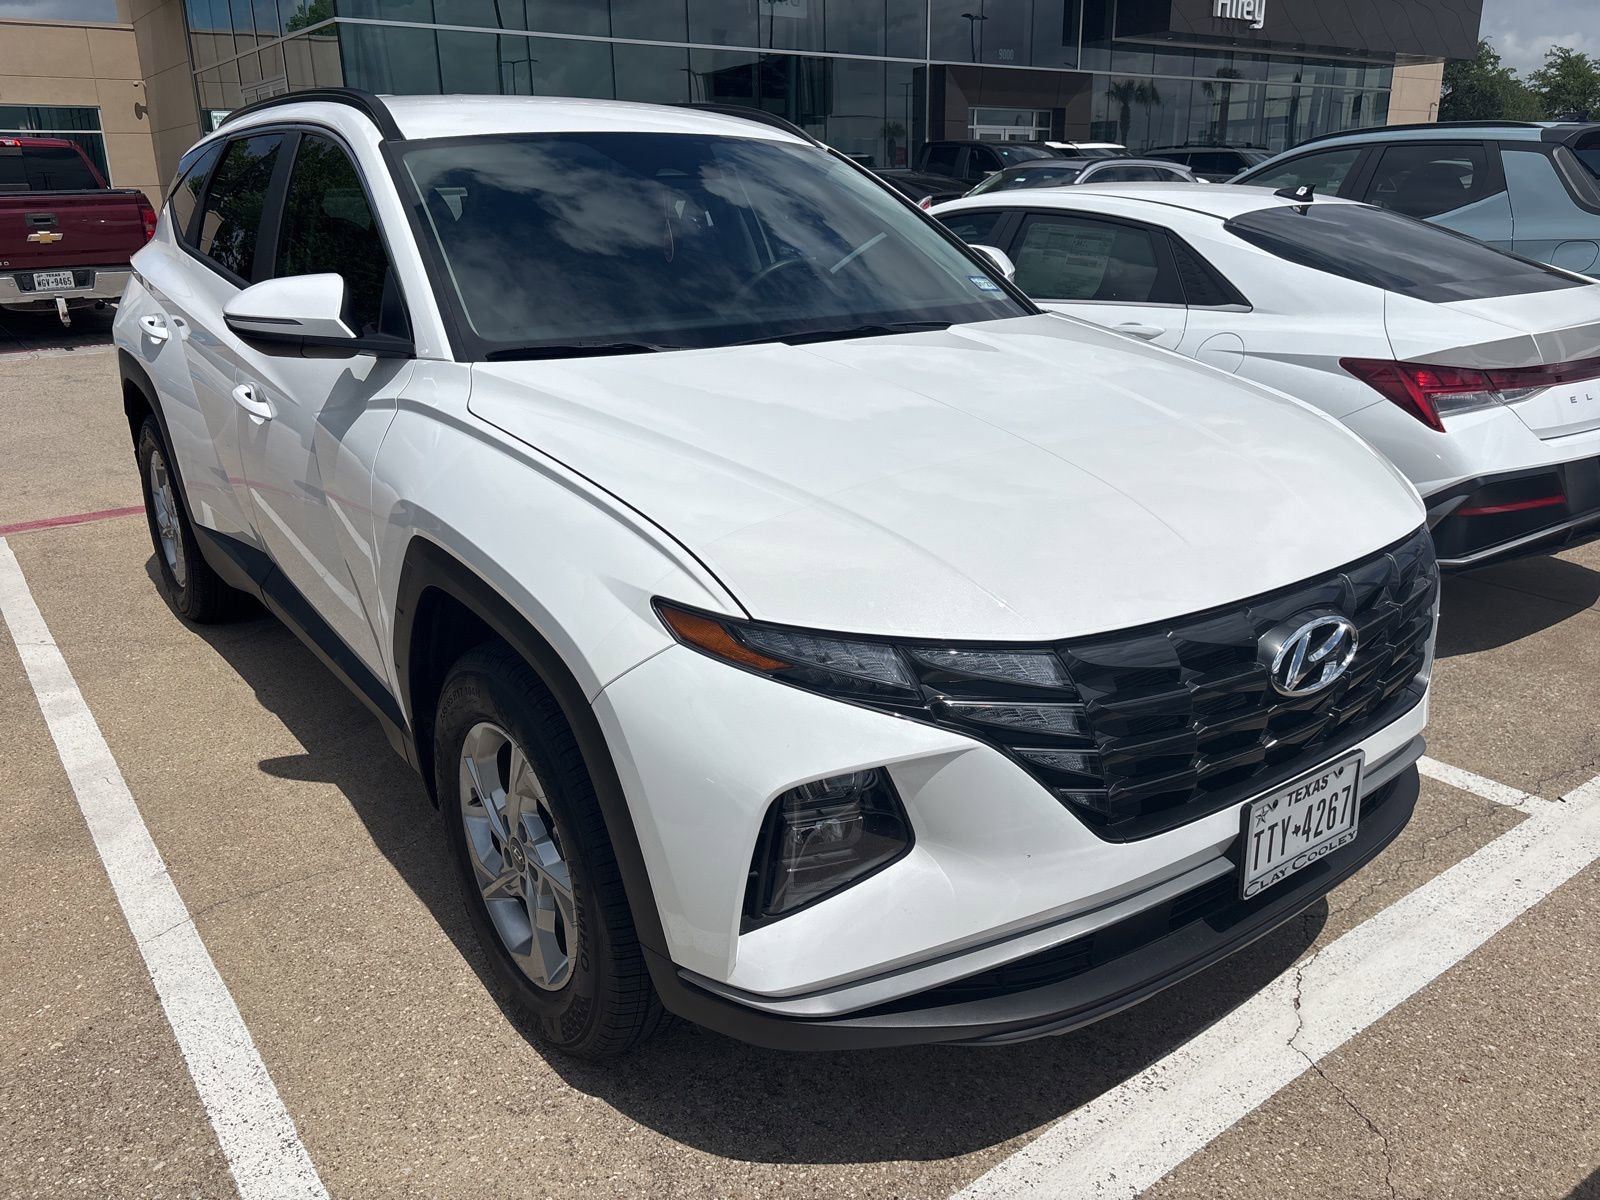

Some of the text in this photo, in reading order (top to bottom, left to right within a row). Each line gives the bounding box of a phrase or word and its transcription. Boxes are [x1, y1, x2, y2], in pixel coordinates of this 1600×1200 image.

[1286, 774, 1329, 807] TEXAS
[1244, 830, 1358, 898] CLAY COOLEY
